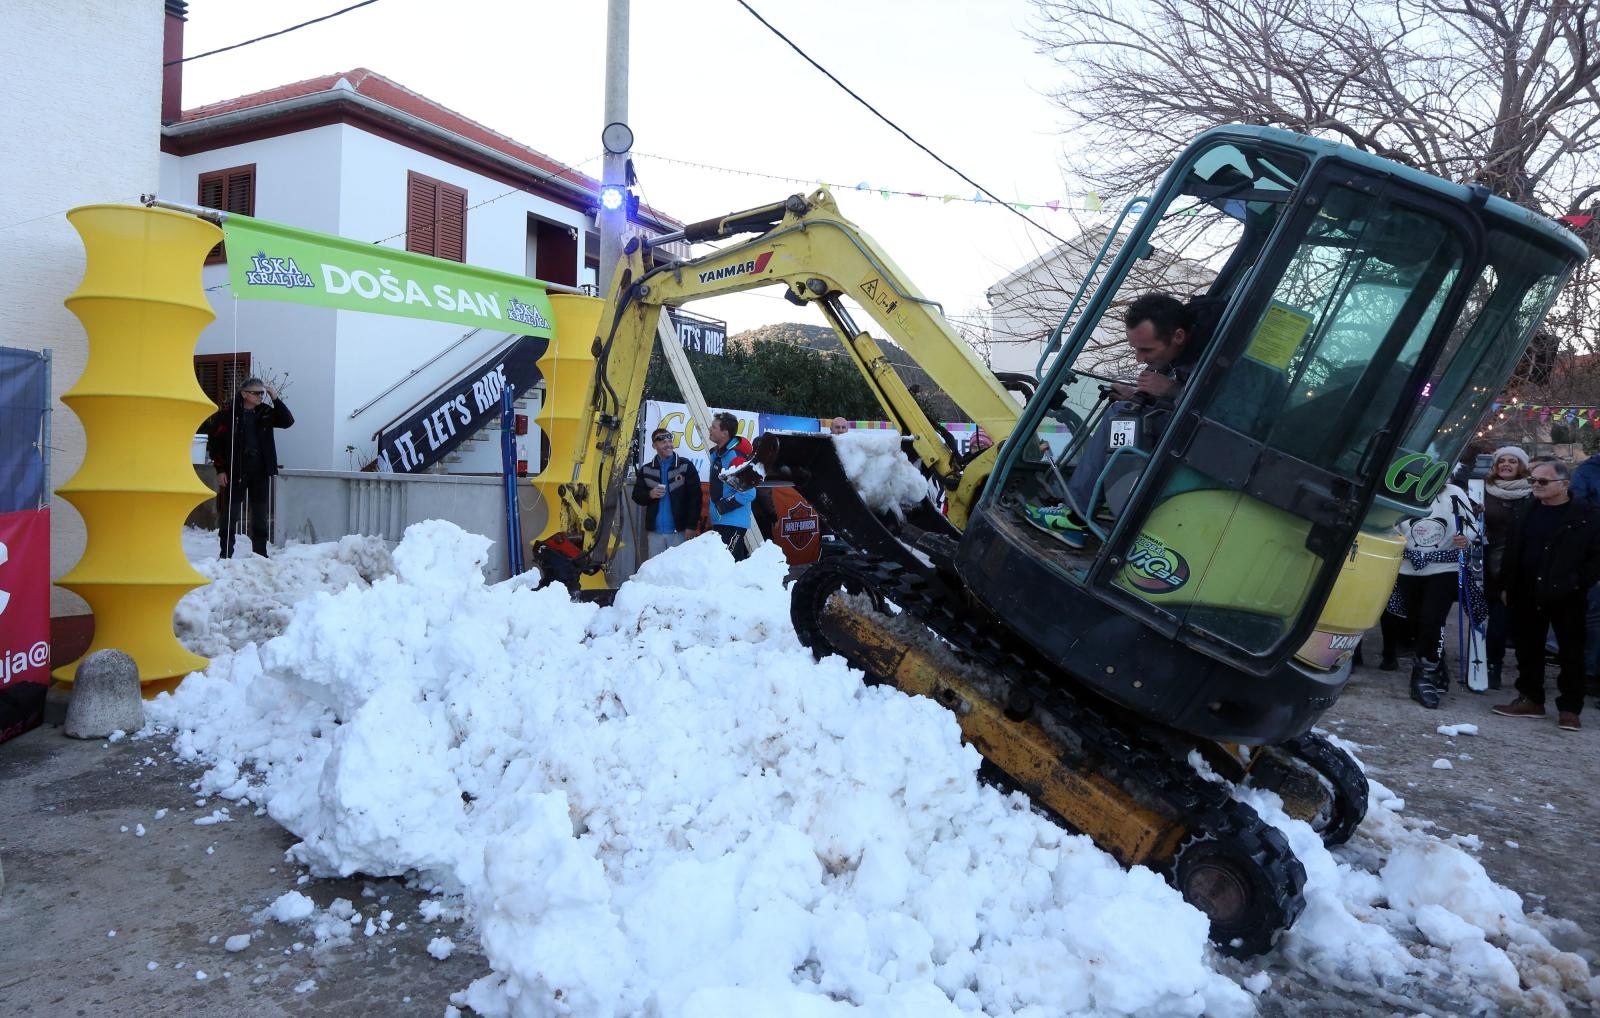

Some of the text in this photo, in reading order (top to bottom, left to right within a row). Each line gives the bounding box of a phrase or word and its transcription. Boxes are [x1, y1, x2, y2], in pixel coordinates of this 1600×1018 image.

[320, 263, 502, 320] DOŠA SAN
[699, 260, 755, 283] YANMAR
[393, 430, 425, 472] IT,
[422, 393, 472, 451] LET'S
[1113, 432, 1126, 446] 93
[1384, 452, 1449, 502] GO
